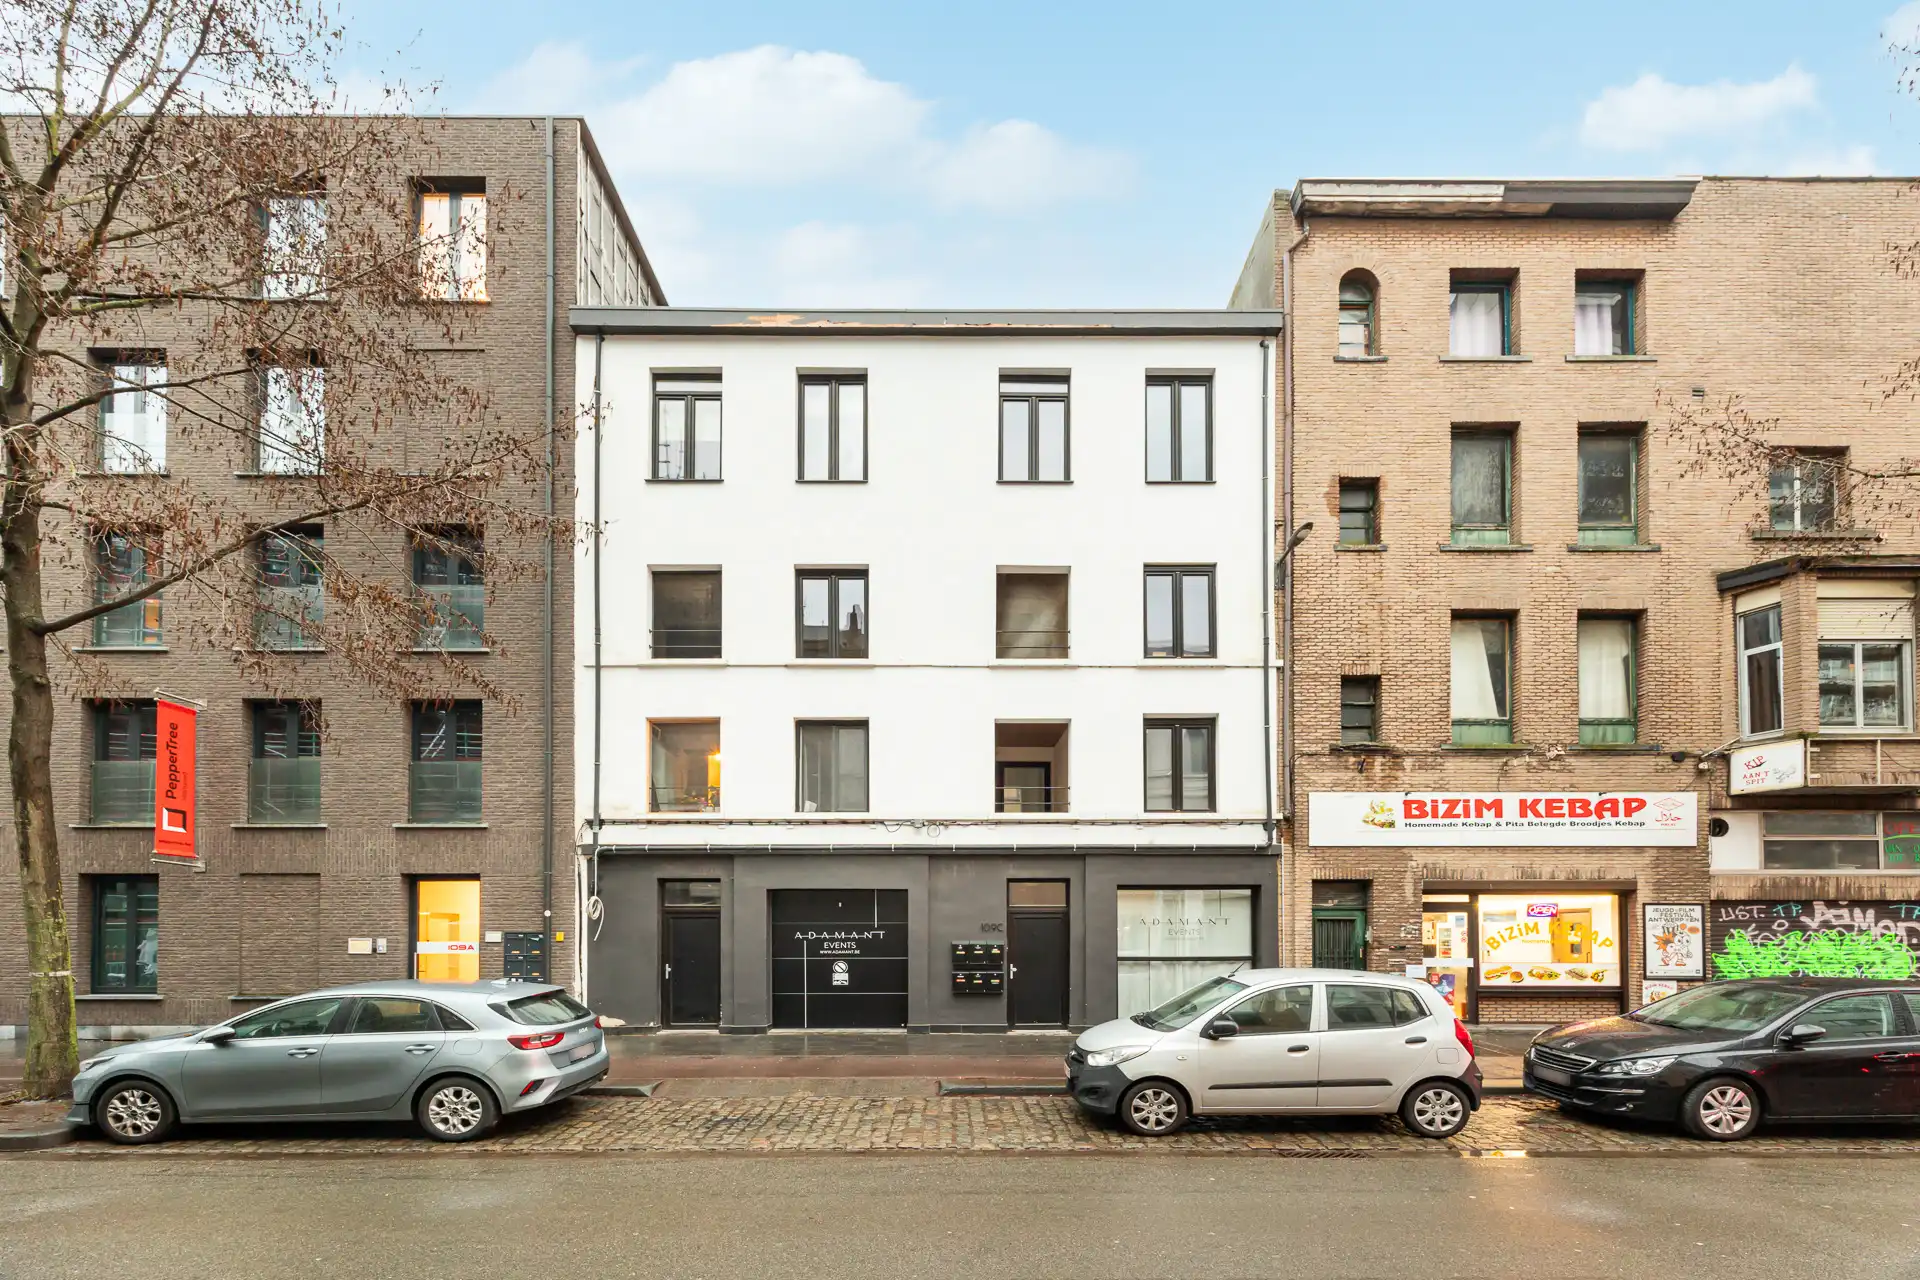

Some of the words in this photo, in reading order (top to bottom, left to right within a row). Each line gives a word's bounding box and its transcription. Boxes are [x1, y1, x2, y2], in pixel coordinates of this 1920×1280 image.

[165, 722, 180, 799] PepperTree
[1744, 755, 1765, 770] KIP
[1518, 797, 1647, 820] KEBAP
[1461, 821, 1492, 829] Kebap
[1570, 820, 1612, 828] Broodjes
[1615, 820, 1646, 828] Kebap
[1528, 904, 1557, 915] OPEN
[1139, 917, 1231, 926] ADAMANT
[981, 923, 1004, 933] 109C
[1168, 928, 1201, 936] EVENTS
[794, 931, 886, 939] ADAMANT
[824, 941, 857, 949] EVENTS
